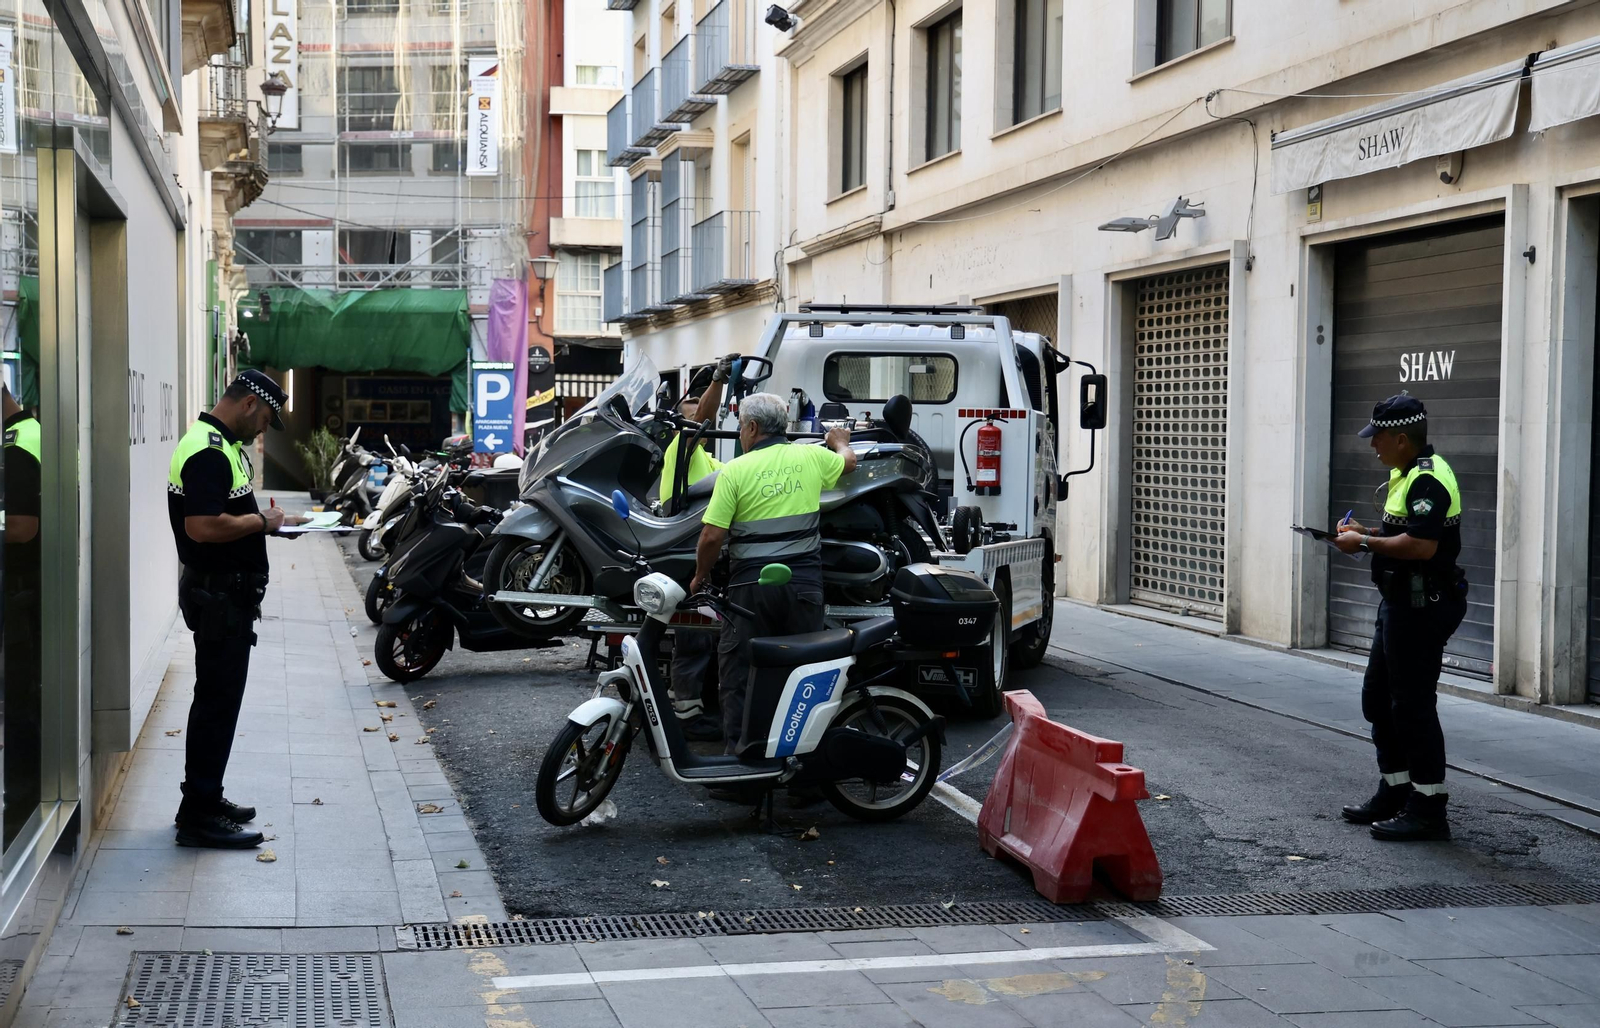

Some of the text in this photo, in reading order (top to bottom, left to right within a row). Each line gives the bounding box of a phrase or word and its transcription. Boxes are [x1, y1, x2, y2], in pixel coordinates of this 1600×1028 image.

[479, 112, 489, 169] ALQUIANSA
[1358, 126, 1404, 161] SHAW
[1399, 350, 1456, 383] SHAW
[477, 373, 511, 417] P
[755, 464, 803, 481] SERVICIO
[761, 476, 804, 498] GRÚA
[958, 617, 977, 625] 0347
[785, 702, 807, 742] cooltra
